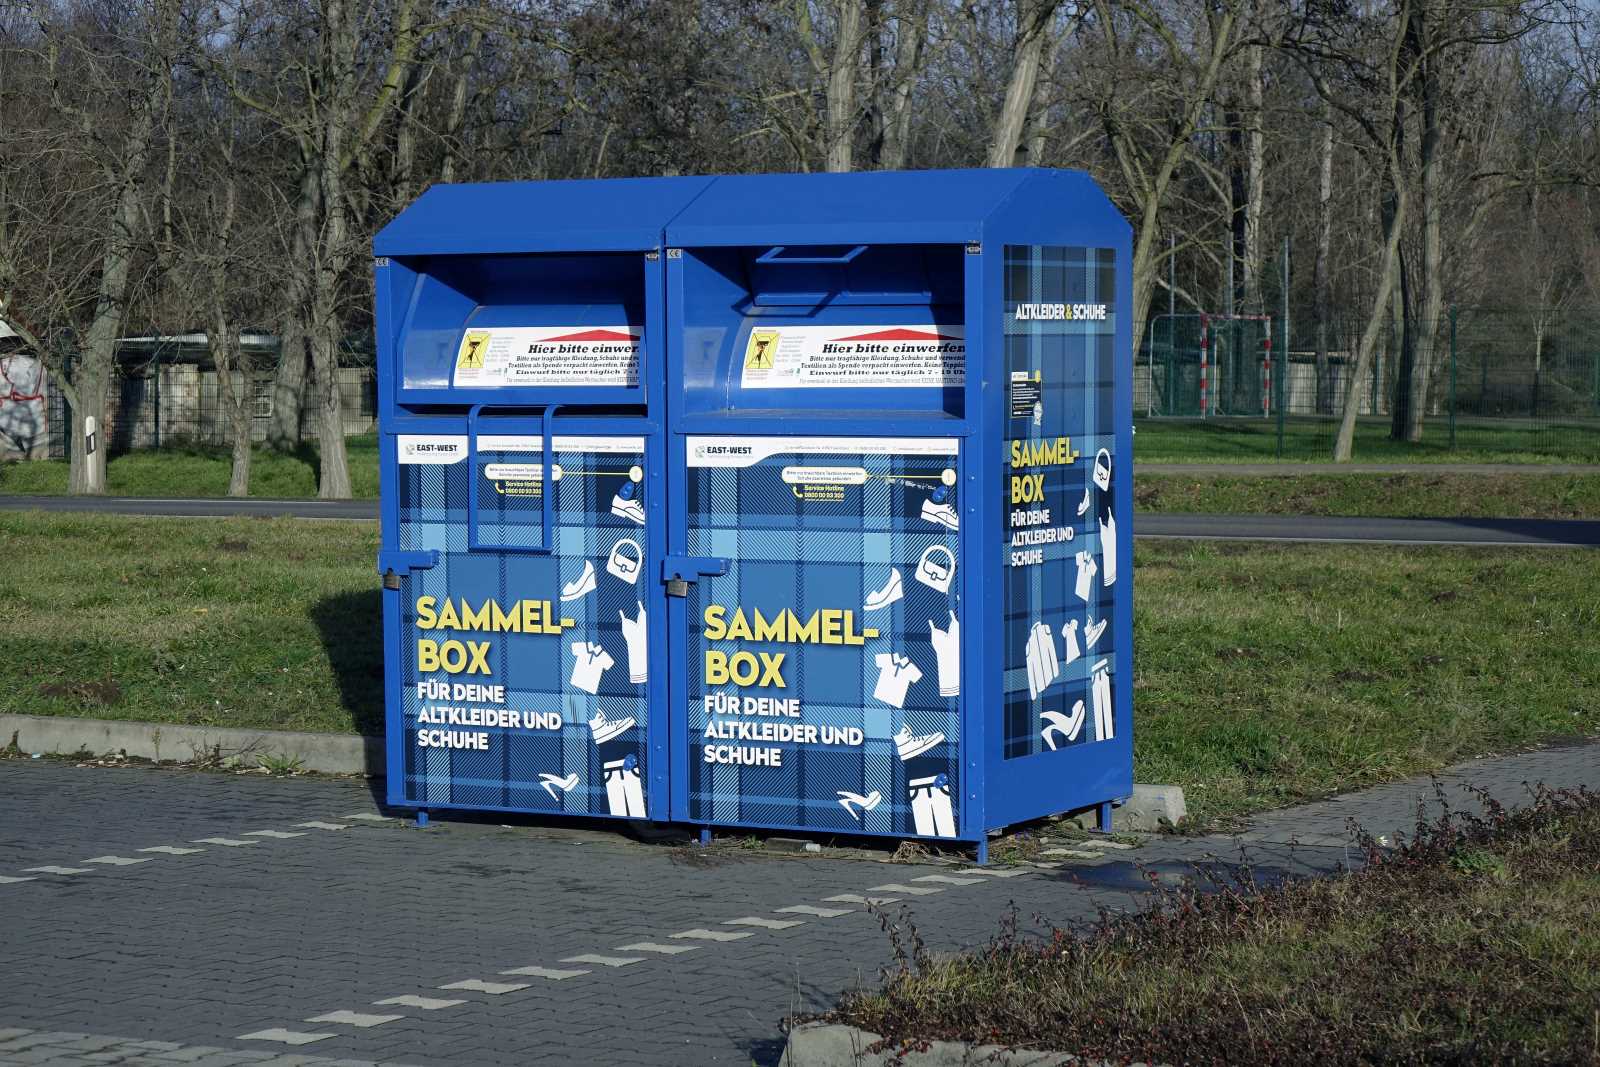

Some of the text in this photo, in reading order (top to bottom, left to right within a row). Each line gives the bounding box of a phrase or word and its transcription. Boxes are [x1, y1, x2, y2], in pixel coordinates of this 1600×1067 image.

[1016, 304, 1106, 320] ALTKLEIDER & SCHUHE
[528, 344, 556, 354] Hier
[558, 344, 589, 353] bitte
[822, 343, 966, 353] Hier bitte einwerfen
[416, 444, 458, 452] EAST-WEST
[707, 446, 752, 454] EAST-WEST
[1010, 436, 1079, 469] SAMMEL-
[1011, 474, 1045, 504] BOX
[1011, 508, 1050, 527] FÜR DEINE
[1012, 526, 1074, 547] ALTKLEIDER UND
[1011, 549, 1043, 567] SCHUHE
[416, 596, 574, 634] SAMMEL-
[704, 605, 879, 645] SAMMEL-
[418, 638, 491, 675] BOX
[705, 650, 786, 688] BOX
[417, 678, 505, 704] FÜR DEINE
[704, 691, 800, 718] FÜR DEINE
[417, 706, 562, 730] ALTKLEIDER UND
[417, 730, 489, 750] SCHUHE
[704, 720, 864, 746] ALTKLEIDER UND
[704, 744, 782, 767] SCHUHE
